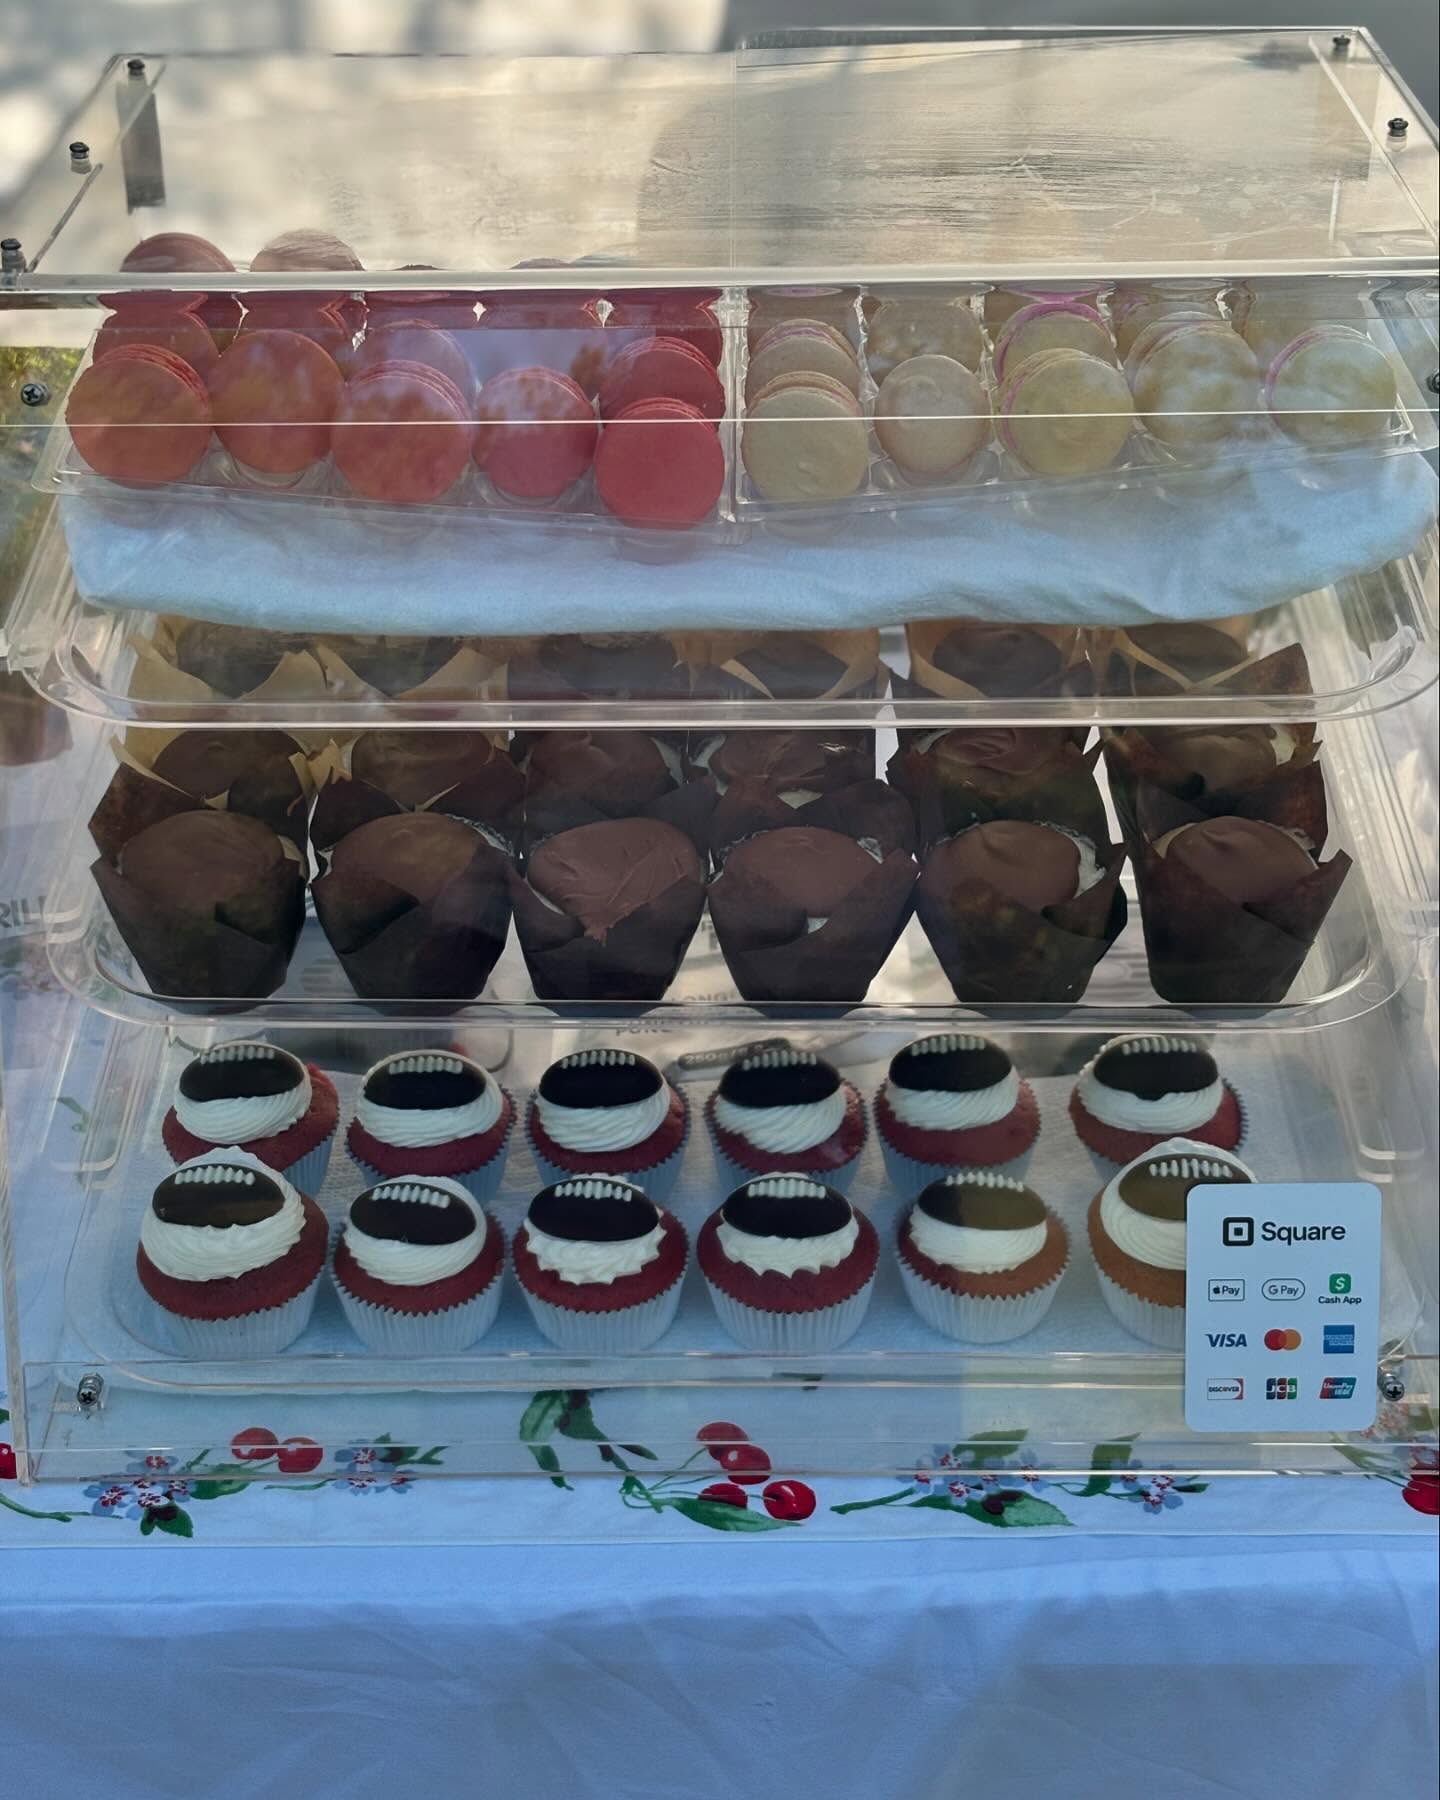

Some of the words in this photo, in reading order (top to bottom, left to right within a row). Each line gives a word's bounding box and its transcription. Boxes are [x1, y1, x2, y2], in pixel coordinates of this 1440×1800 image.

[1261, 1221, 1346, 1246] Square
[1222, 1285, 1240, 1296] Pay
[1280, 1285, 1299, 1296] Pay
[1318, 1295, 1341, 1304] Cash
[1342, 1295, 1362, 1304] App
[1205, 1333, 1248, 1347] VISA
[1266, 1384, 1296, 1393] JCB
